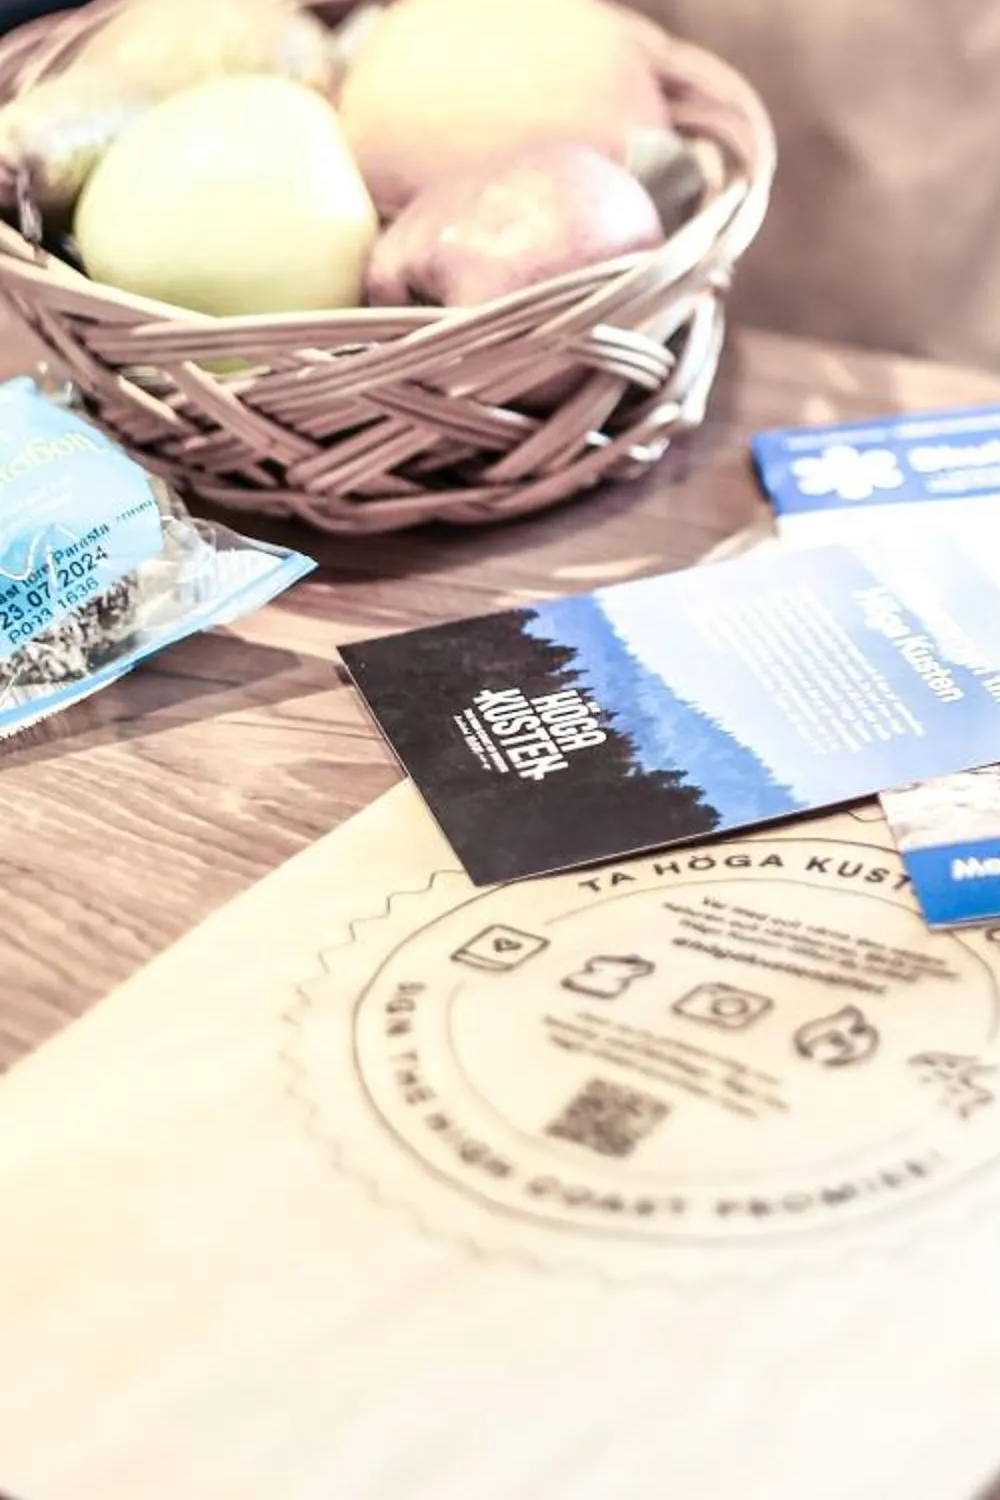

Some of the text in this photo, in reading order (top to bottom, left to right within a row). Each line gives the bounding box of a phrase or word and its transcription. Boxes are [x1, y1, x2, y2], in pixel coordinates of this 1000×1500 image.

[473, 688, 569, 781] KUSTEN
[530, 689, 608, 753] HÖGA
[577, 871, 637, 893] TA
[653, 853, 784, 877] HÖGA
